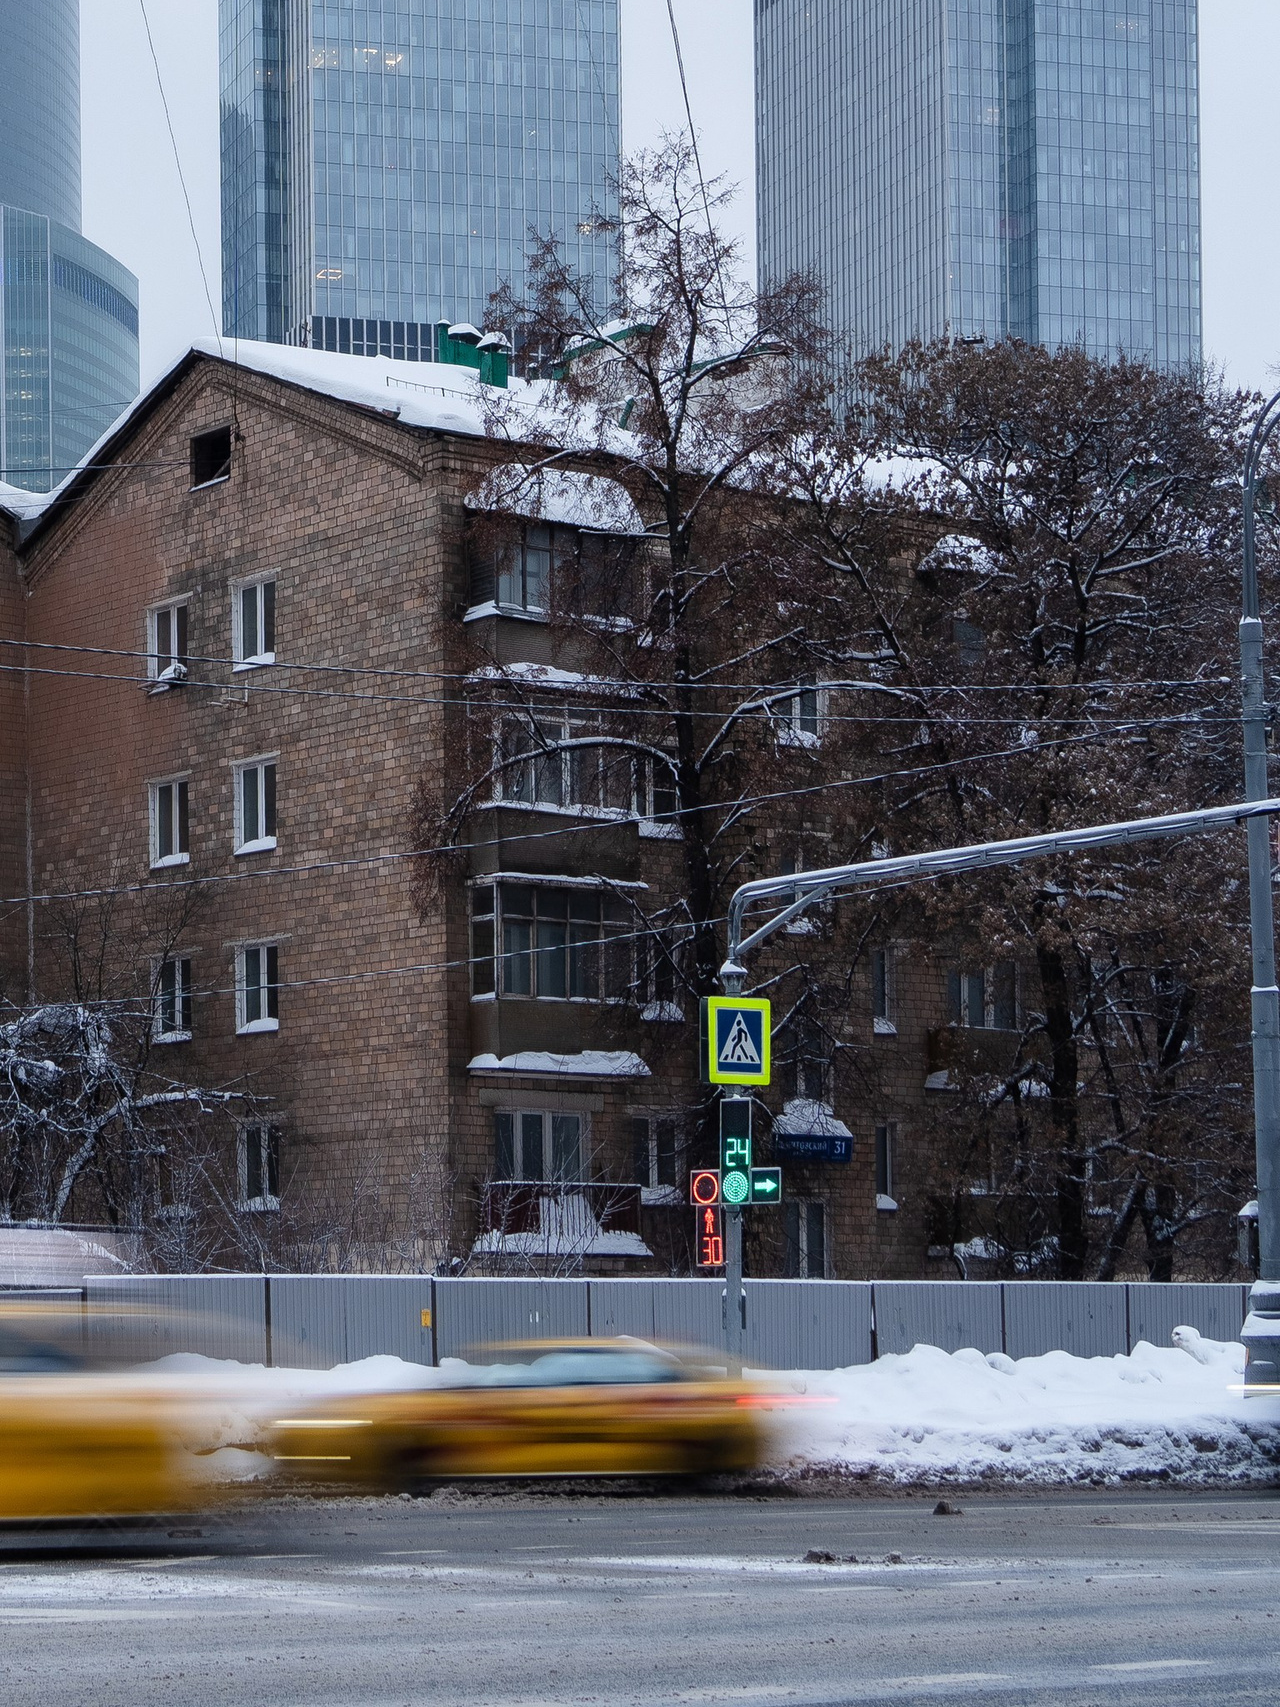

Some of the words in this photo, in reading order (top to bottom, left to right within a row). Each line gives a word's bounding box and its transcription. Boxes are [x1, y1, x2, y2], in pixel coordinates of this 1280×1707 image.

[725, 1138, 749, 1167] 24
[833, 1140, 846, 1154] 31
[702, 1236, 723, 1265] 30
